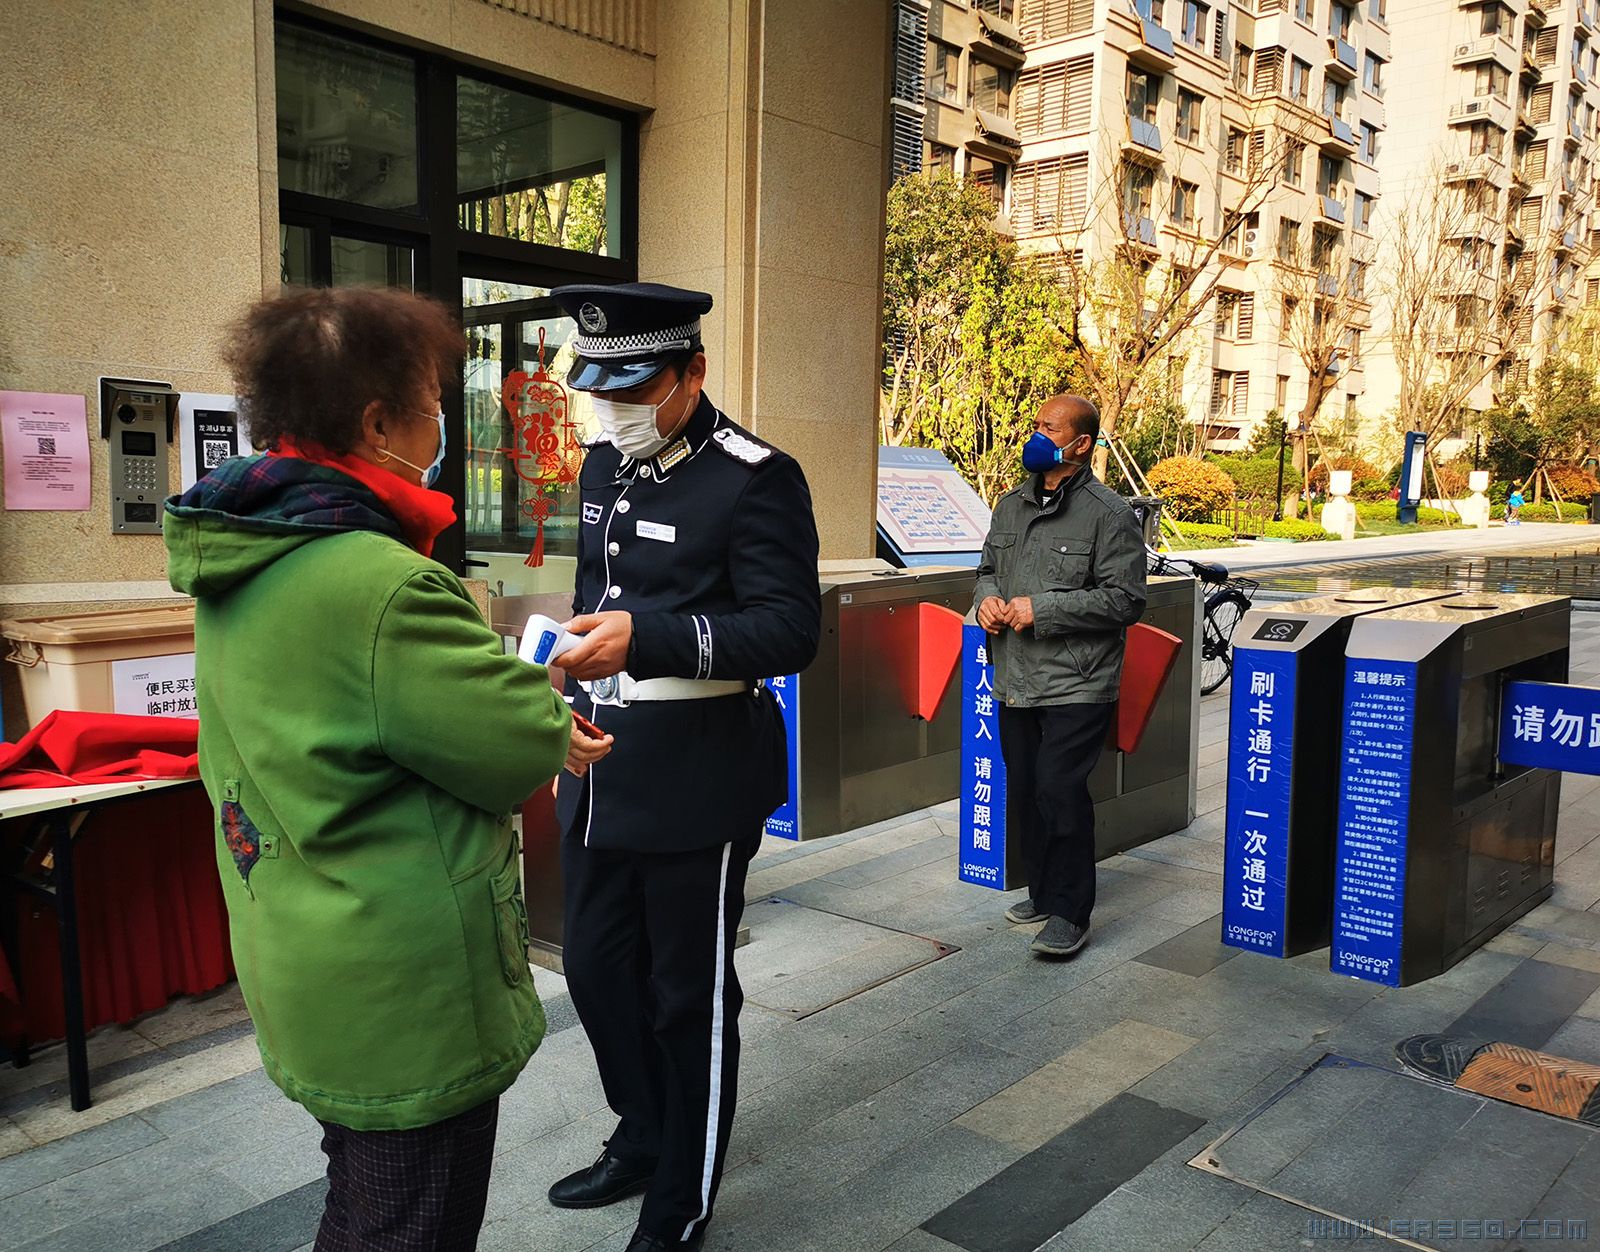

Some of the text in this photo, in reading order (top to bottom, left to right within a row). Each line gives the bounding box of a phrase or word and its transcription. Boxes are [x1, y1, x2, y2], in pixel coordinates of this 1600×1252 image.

[1353, 671, 1406, 687] 温馨提示
[974, 644, 992, 851] 单人进入 请勿跟随
[1241, 671, 1275, 911] 刷卡通行 一次通过
[766, 817, 792, 828] LONGFOR
[963, 862, 997, 876] LONGFOR
[1228, 924, 1273, 941] LONGFOR
[1339, 951, 1389, 969] LONGFOR
